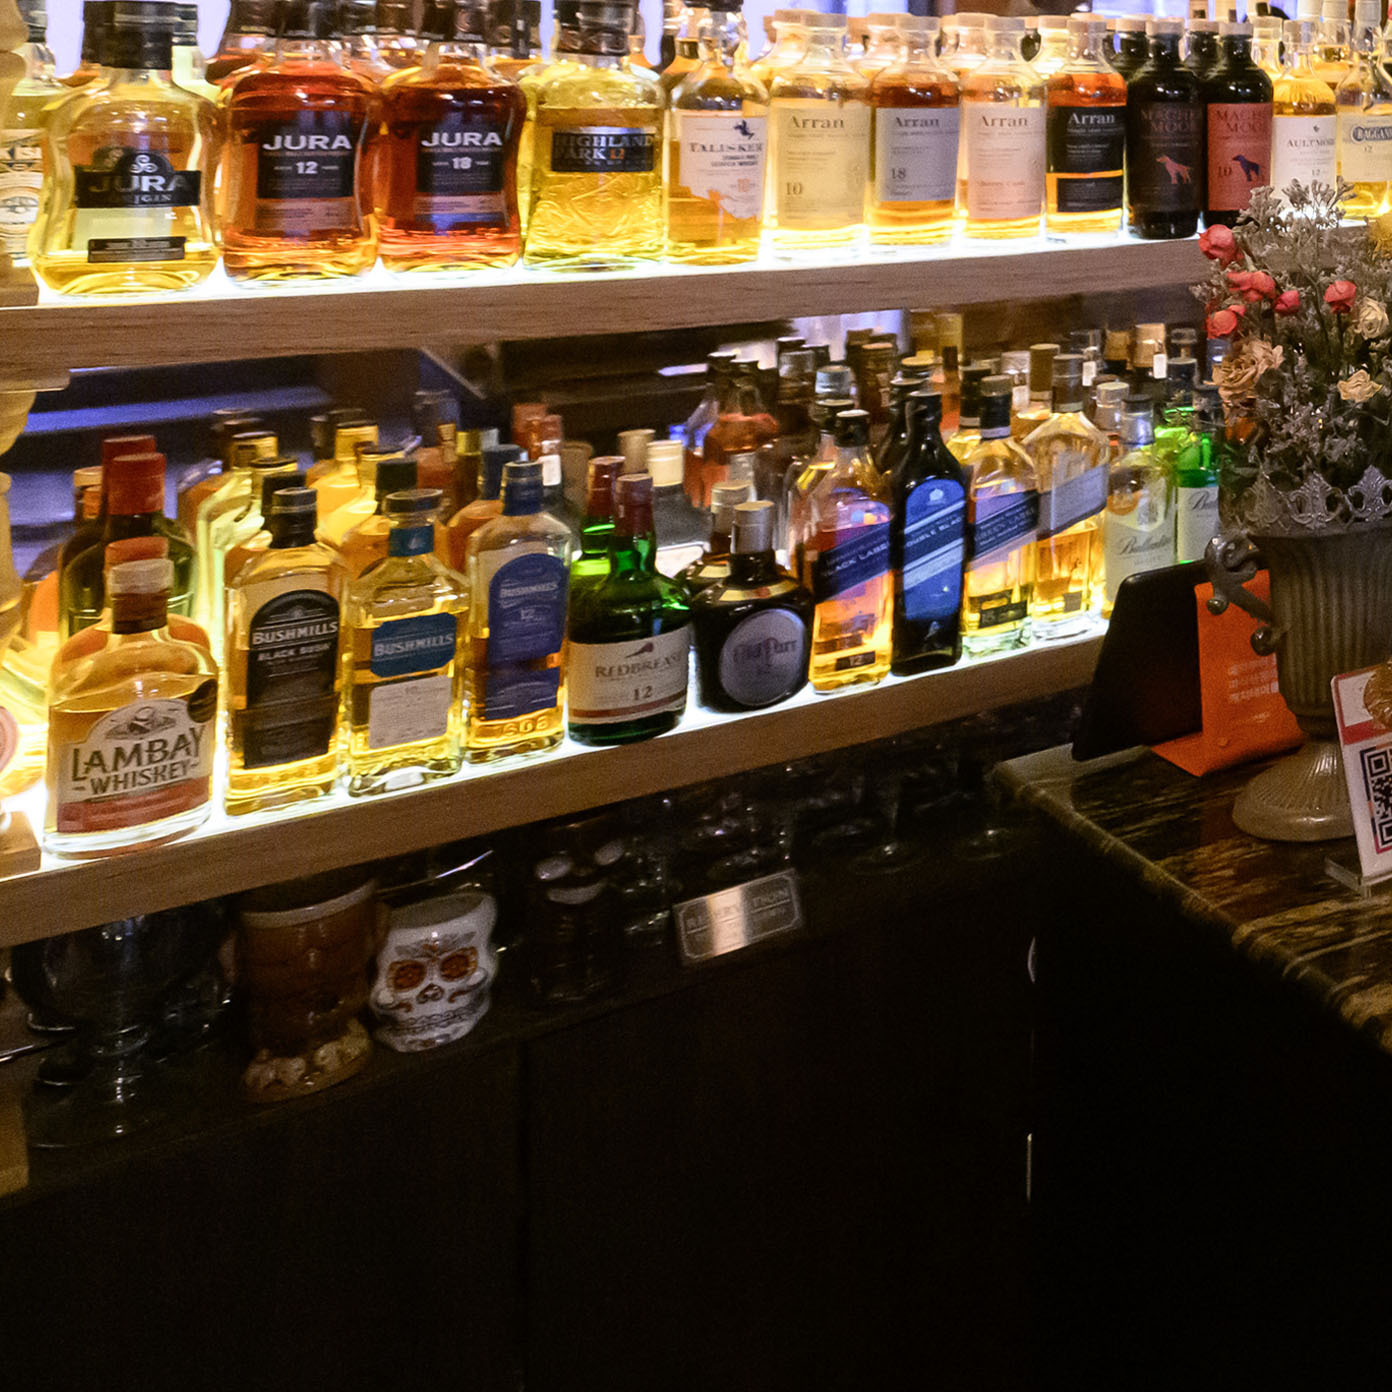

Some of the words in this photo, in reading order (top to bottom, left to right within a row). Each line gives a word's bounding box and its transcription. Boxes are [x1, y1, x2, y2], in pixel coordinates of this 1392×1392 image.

[790, 115, 845, 129] Arran
[894, 116, 940, 128] Arran
[981, 115, 1029, 127] Arran
[1068, 112, 1116, 125] Arran
[263, 135, 353, 151] JURA
[421, 132, 503, 147] JURA
[296, 161, 318, 174] 12
[452, 157, 472, 170] 18
[890, 167, 907, 179] 18
[89, 175, 190, 193] JURA
[786, 182, 803, 195] 10
[252, 620, 339, 646] BUSHMILLS
[374, 633, 455, 657] BUSHMILLS
[258, 648, 296, 662] BLACK
[633, 685, 654, 701] 12
[72, 727, 206, 782] LAMBAY
[90, 762, 191, 795] WHISKEY
